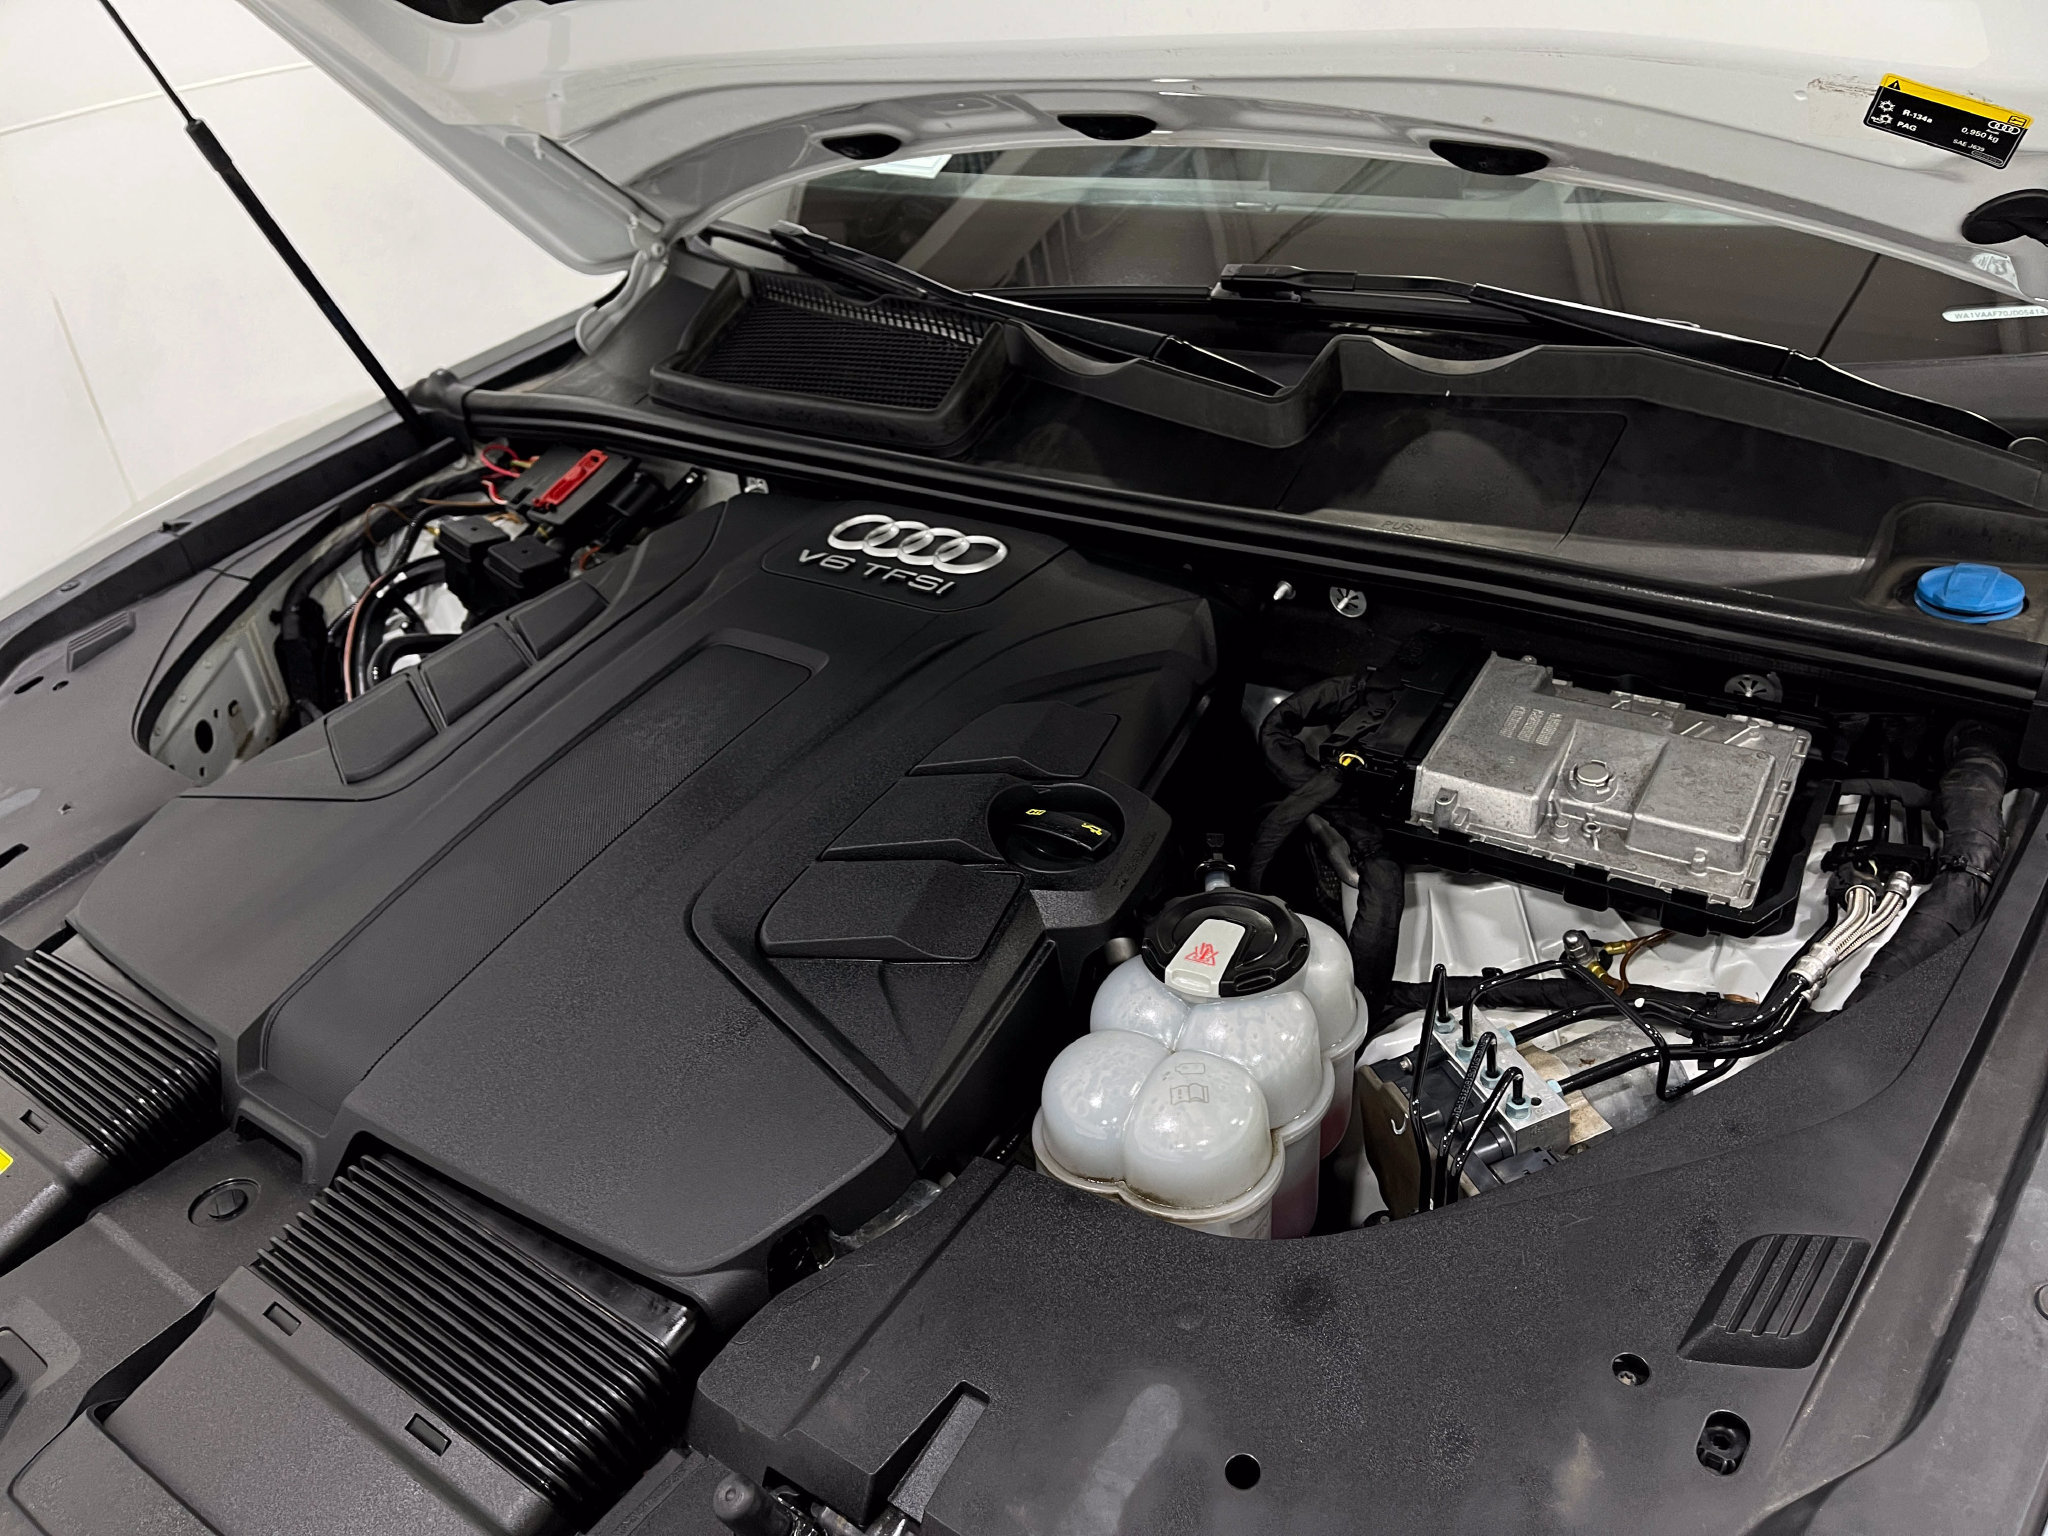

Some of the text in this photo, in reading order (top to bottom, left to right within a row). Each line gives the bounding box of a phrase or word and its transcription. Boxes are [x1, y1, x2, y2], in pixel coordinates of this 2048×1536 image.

[1902, 109, 1933, 124] R-134a
[1896, 120, 1918, 132] PAG
[1961, 127, 2000, 143] 0,950 kg
[1952, 138, 1967, 148] SAE
[1381, 520, 1424, 533] PUSH
[799, 549, 955, 595] V6 TFSI
